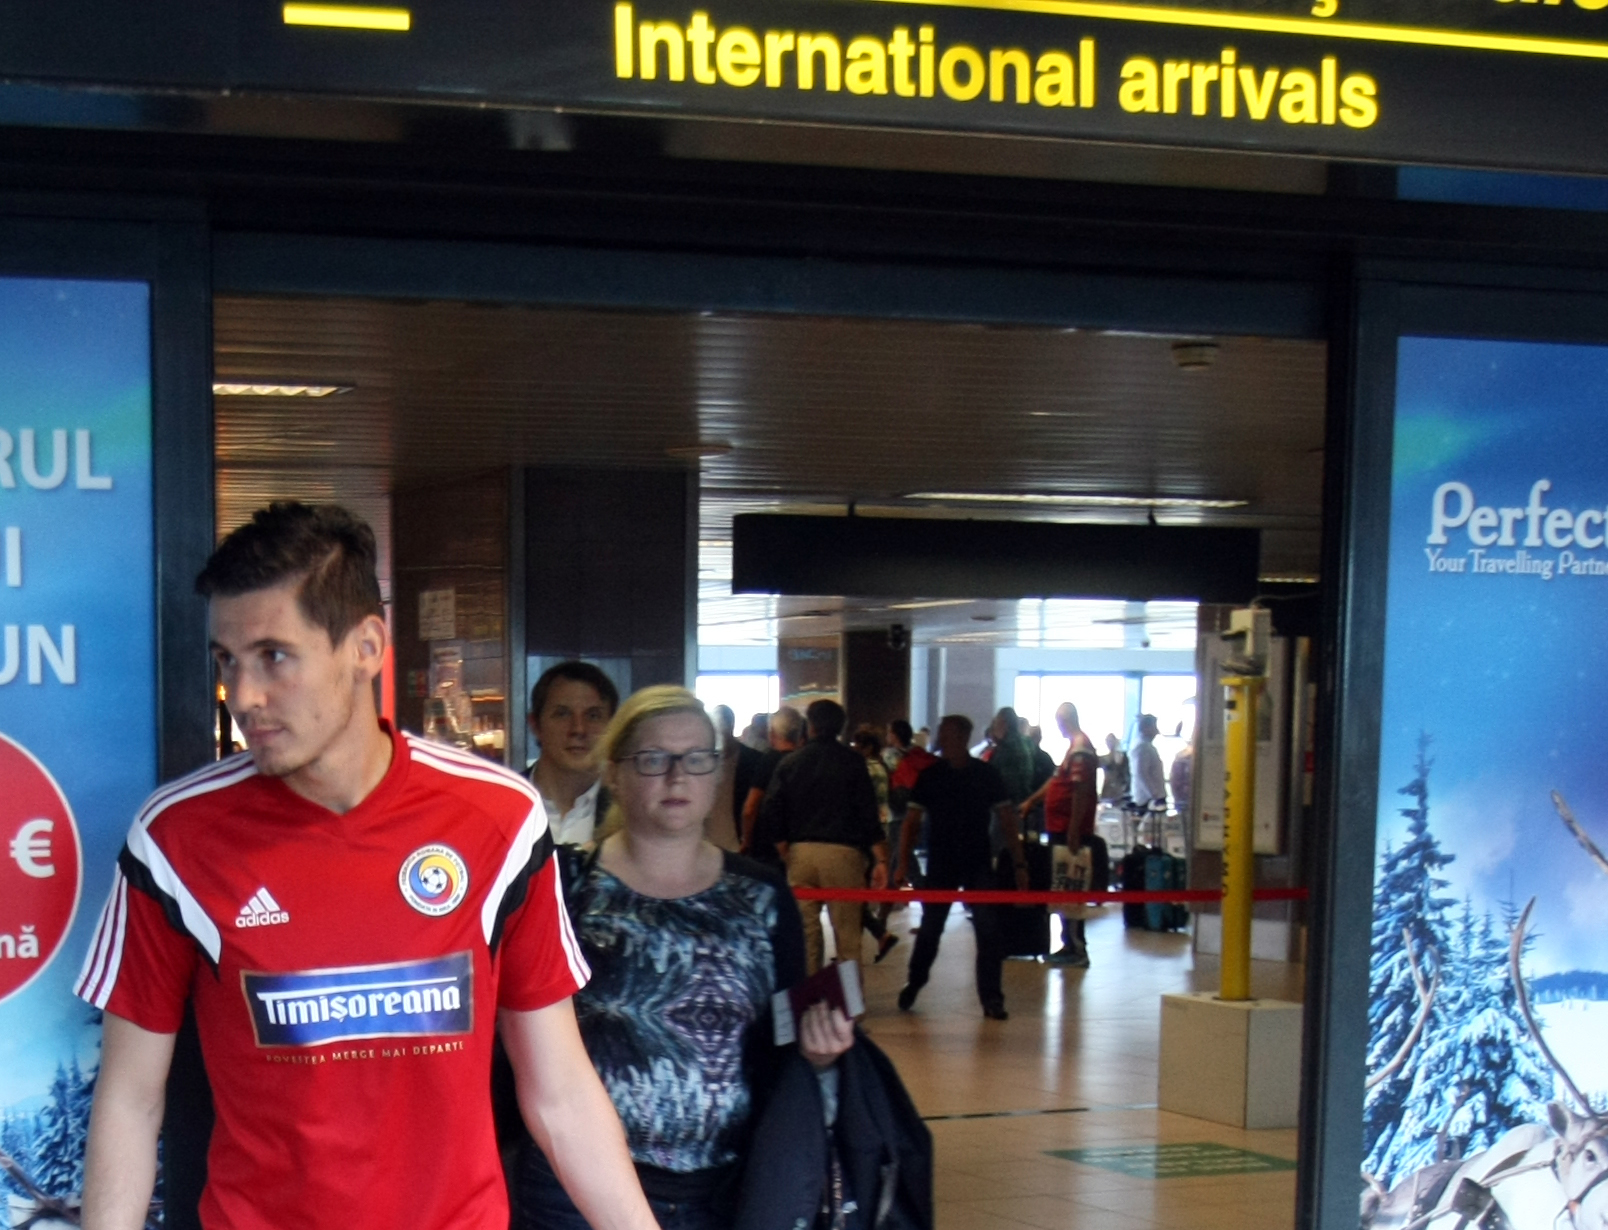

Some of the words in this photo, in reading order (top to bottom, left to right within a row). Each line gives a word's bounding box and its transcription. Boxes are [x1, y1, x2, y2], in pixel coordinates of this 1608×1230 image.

[614, 3, 1095, 108] International
[1118, 47, 1379, 128] arrivals
[1424, 548, 1466, 572] Your
[1468, 549, 1554, 580] Travelling
[1557, 550, 1608, 576] Partn
[9, 819, 56, 878] €
[235, 911, 290, 928] adidas
[332, 1049, 375, 1061] MERGE
[382, 1048, 406, 1058] MAI
[413, 1041, 464, 1055] DEPARTE
